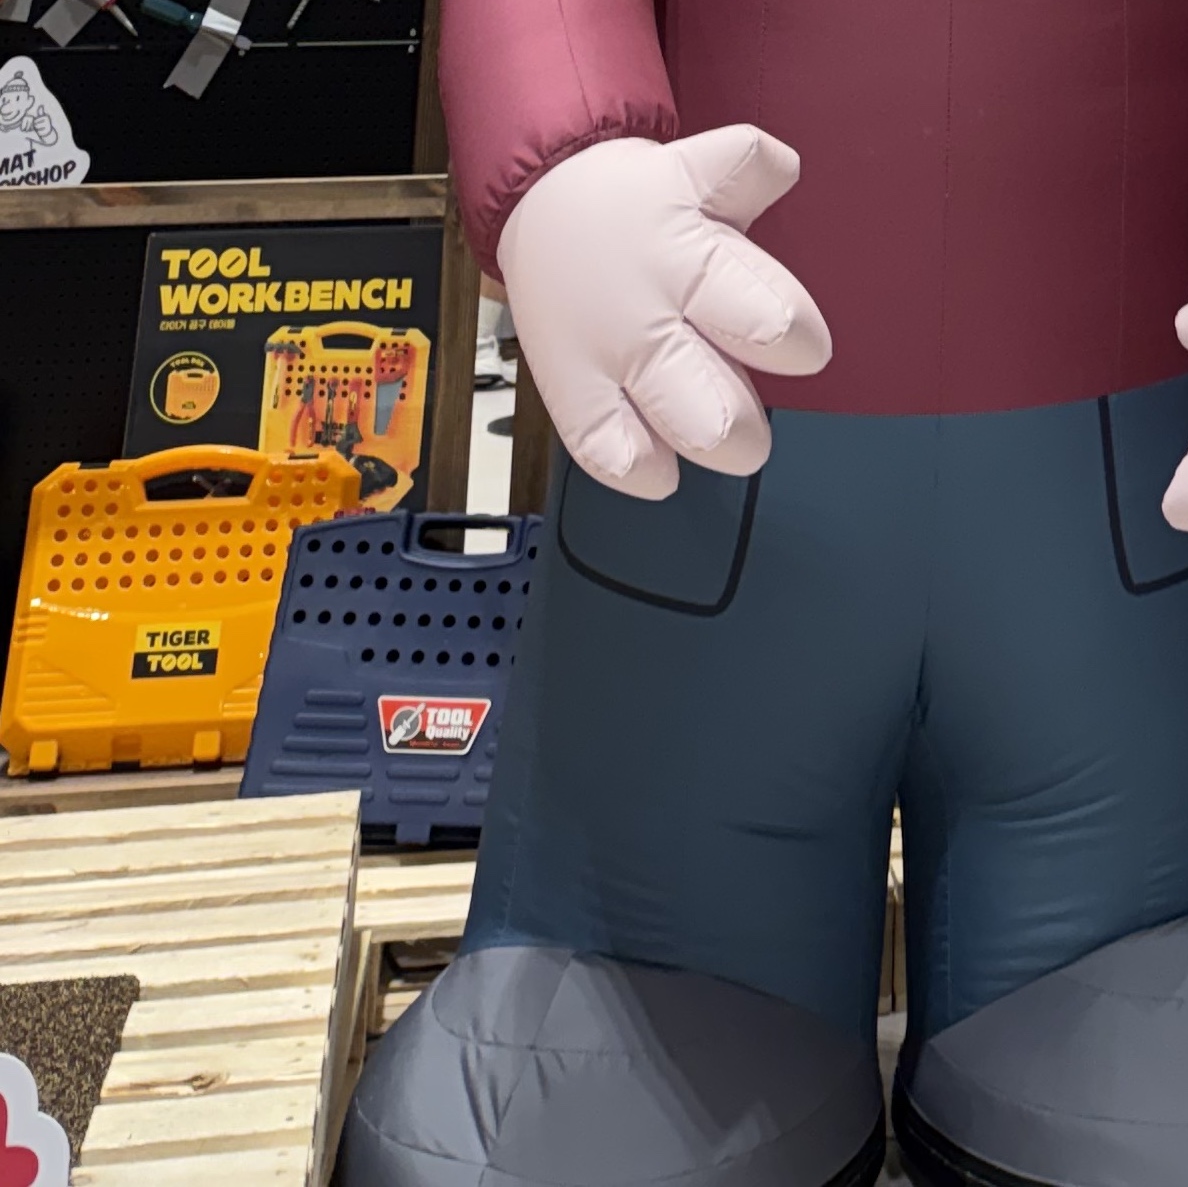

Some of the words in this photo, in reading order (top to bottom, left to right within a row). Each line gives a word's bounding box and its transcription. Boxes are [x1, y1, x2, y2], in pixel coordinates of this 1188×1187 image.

[161, 247, 270, 279] TOOL
[160, 278, 412, 315] WORKBENCH
[146, 629, 210, 647] TIGER
[147, 653, 203, 672] TOOL
[426, 707, 473, 726] TOOL
[425, 725, 471, 742] Quality
